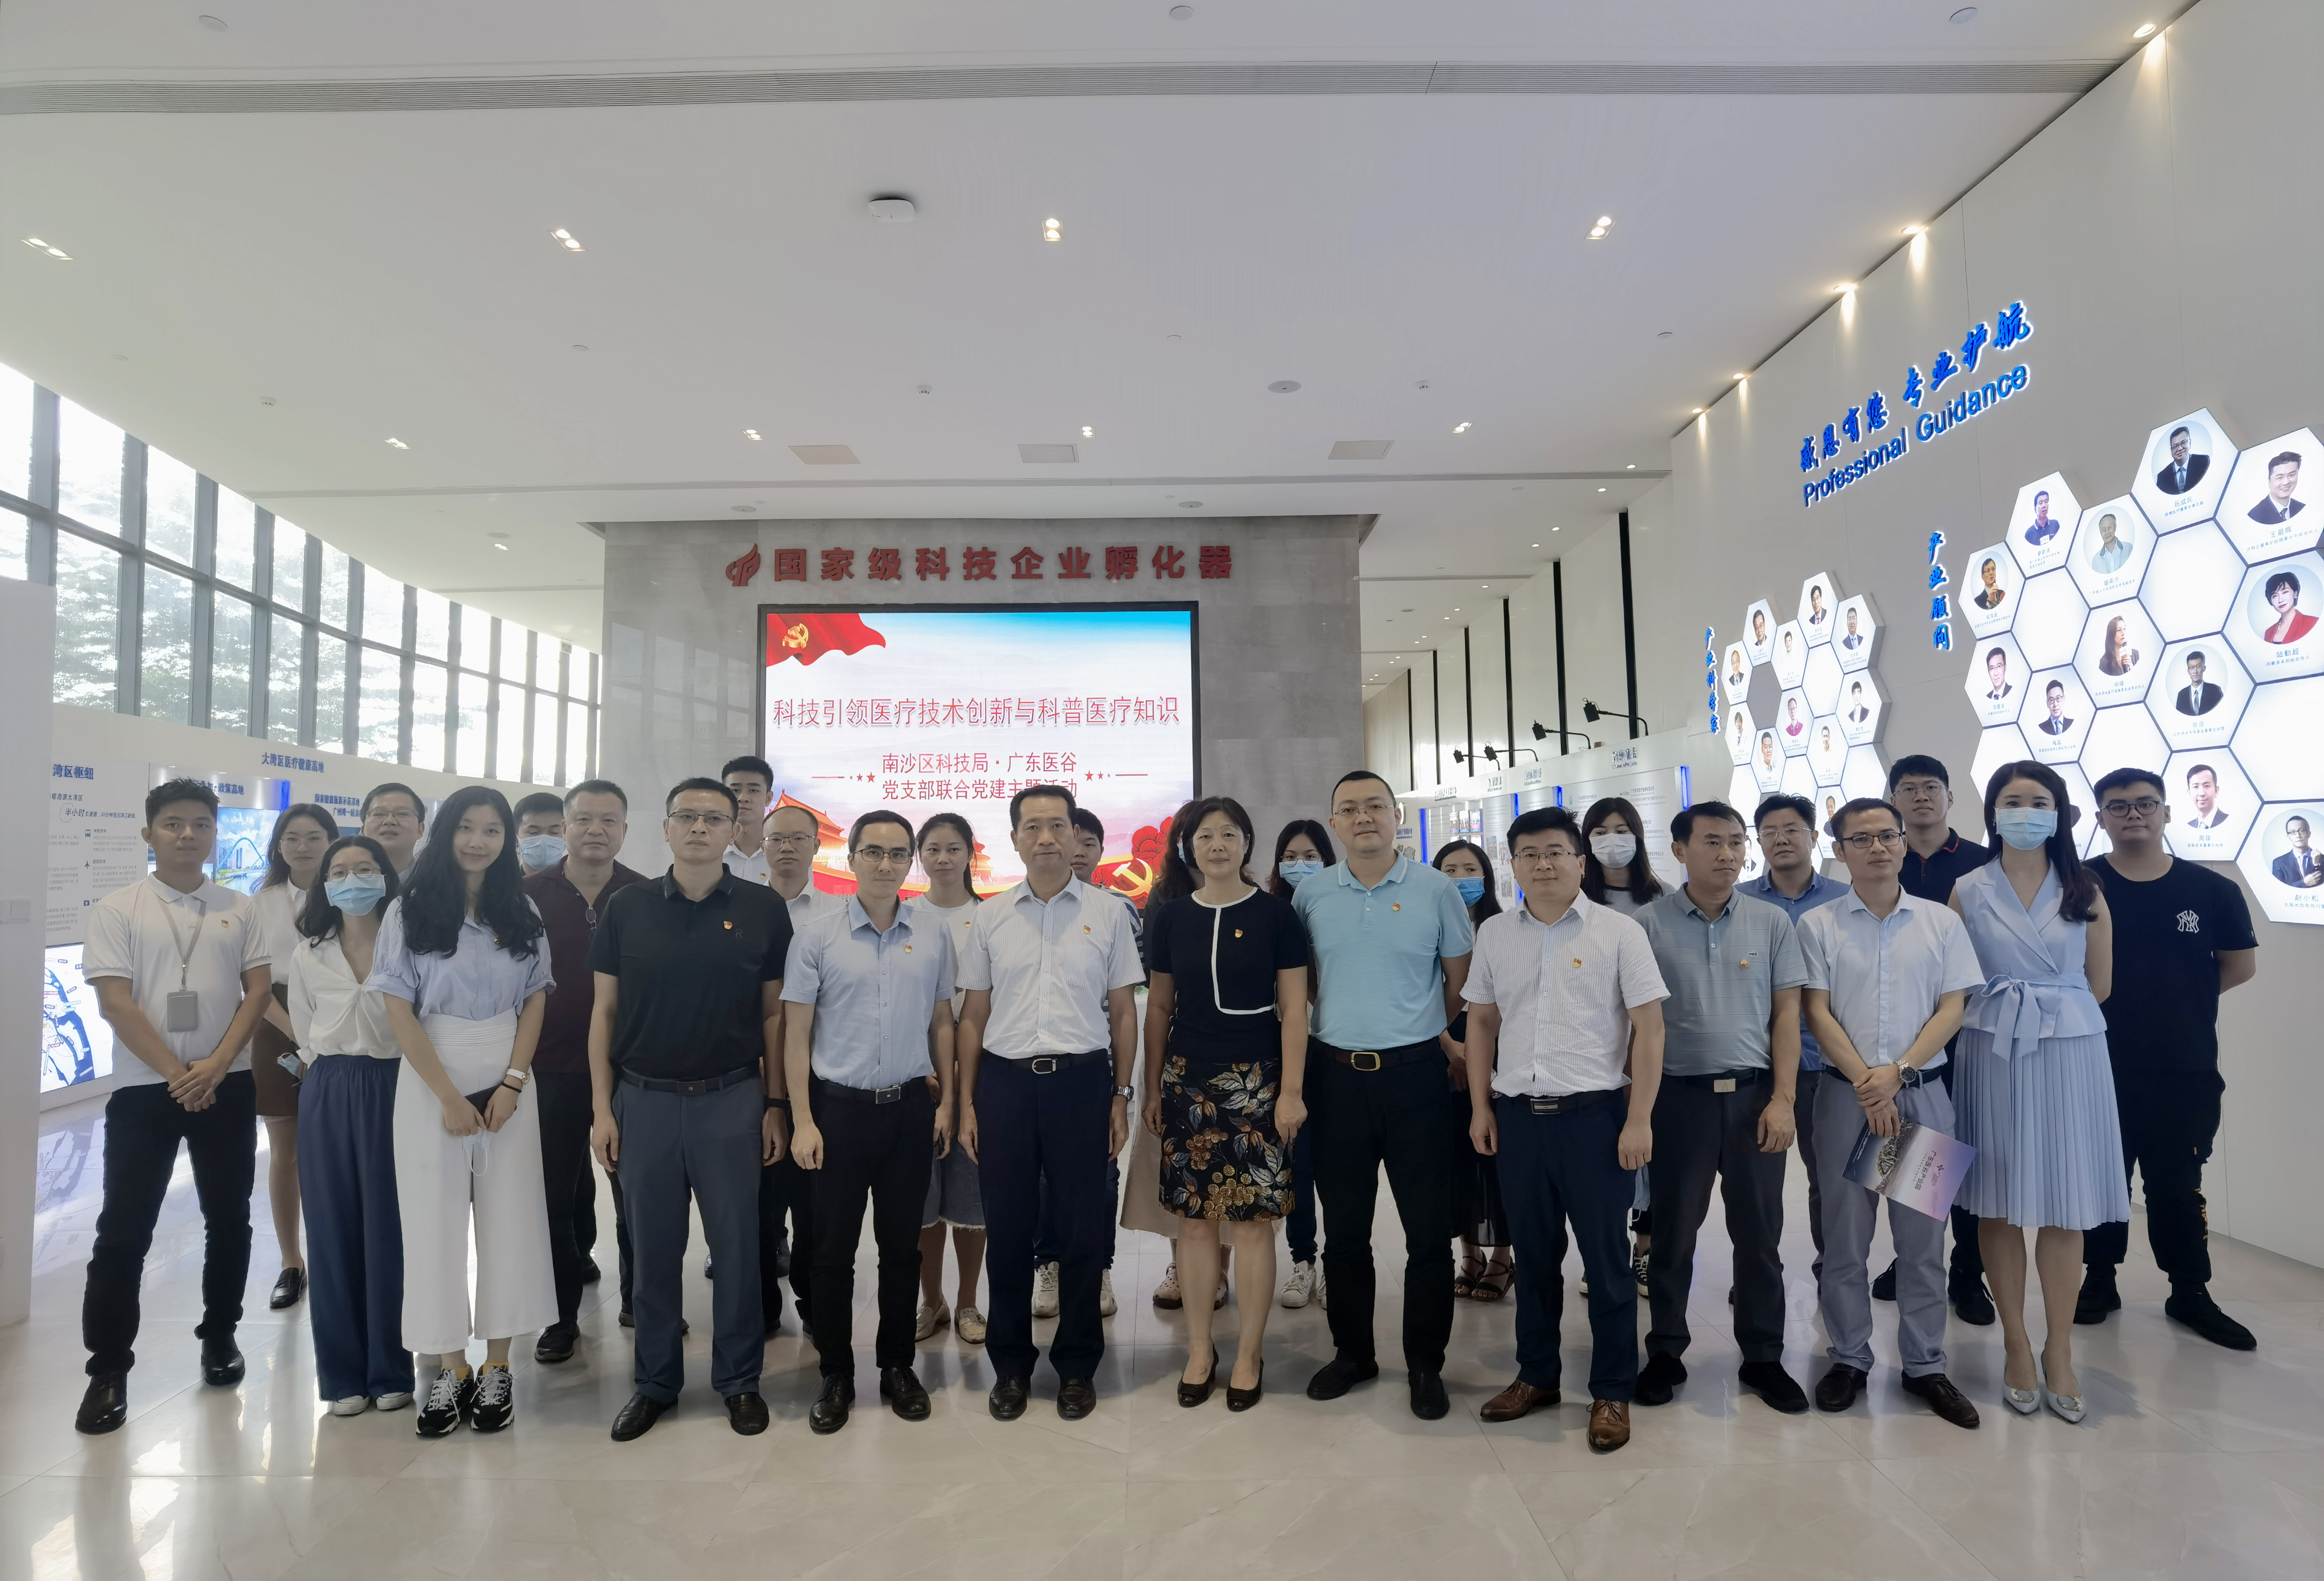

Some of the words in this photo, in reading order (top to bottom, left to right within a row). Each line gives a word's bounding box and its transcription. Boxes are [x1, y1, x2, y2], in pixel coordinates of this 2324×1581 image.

[1903, 301, 2033, 407] 专业护航
[1803, 425, 1909, 507] Professional
[1916, 364, 2029, 442] Guidance
[775, 546, 1232, 580] 国家级科技企业孵化器
[1928, 532, 1950, 650] 产业顾问
[774, 697, 1179, 726] 科技引领医疗技术创新与科普医疗知识
[261, 752, 324, 773] 大湾区医疗健康高地
[883, 752, 1077, 773] 南沙区科技局·广东医谷
